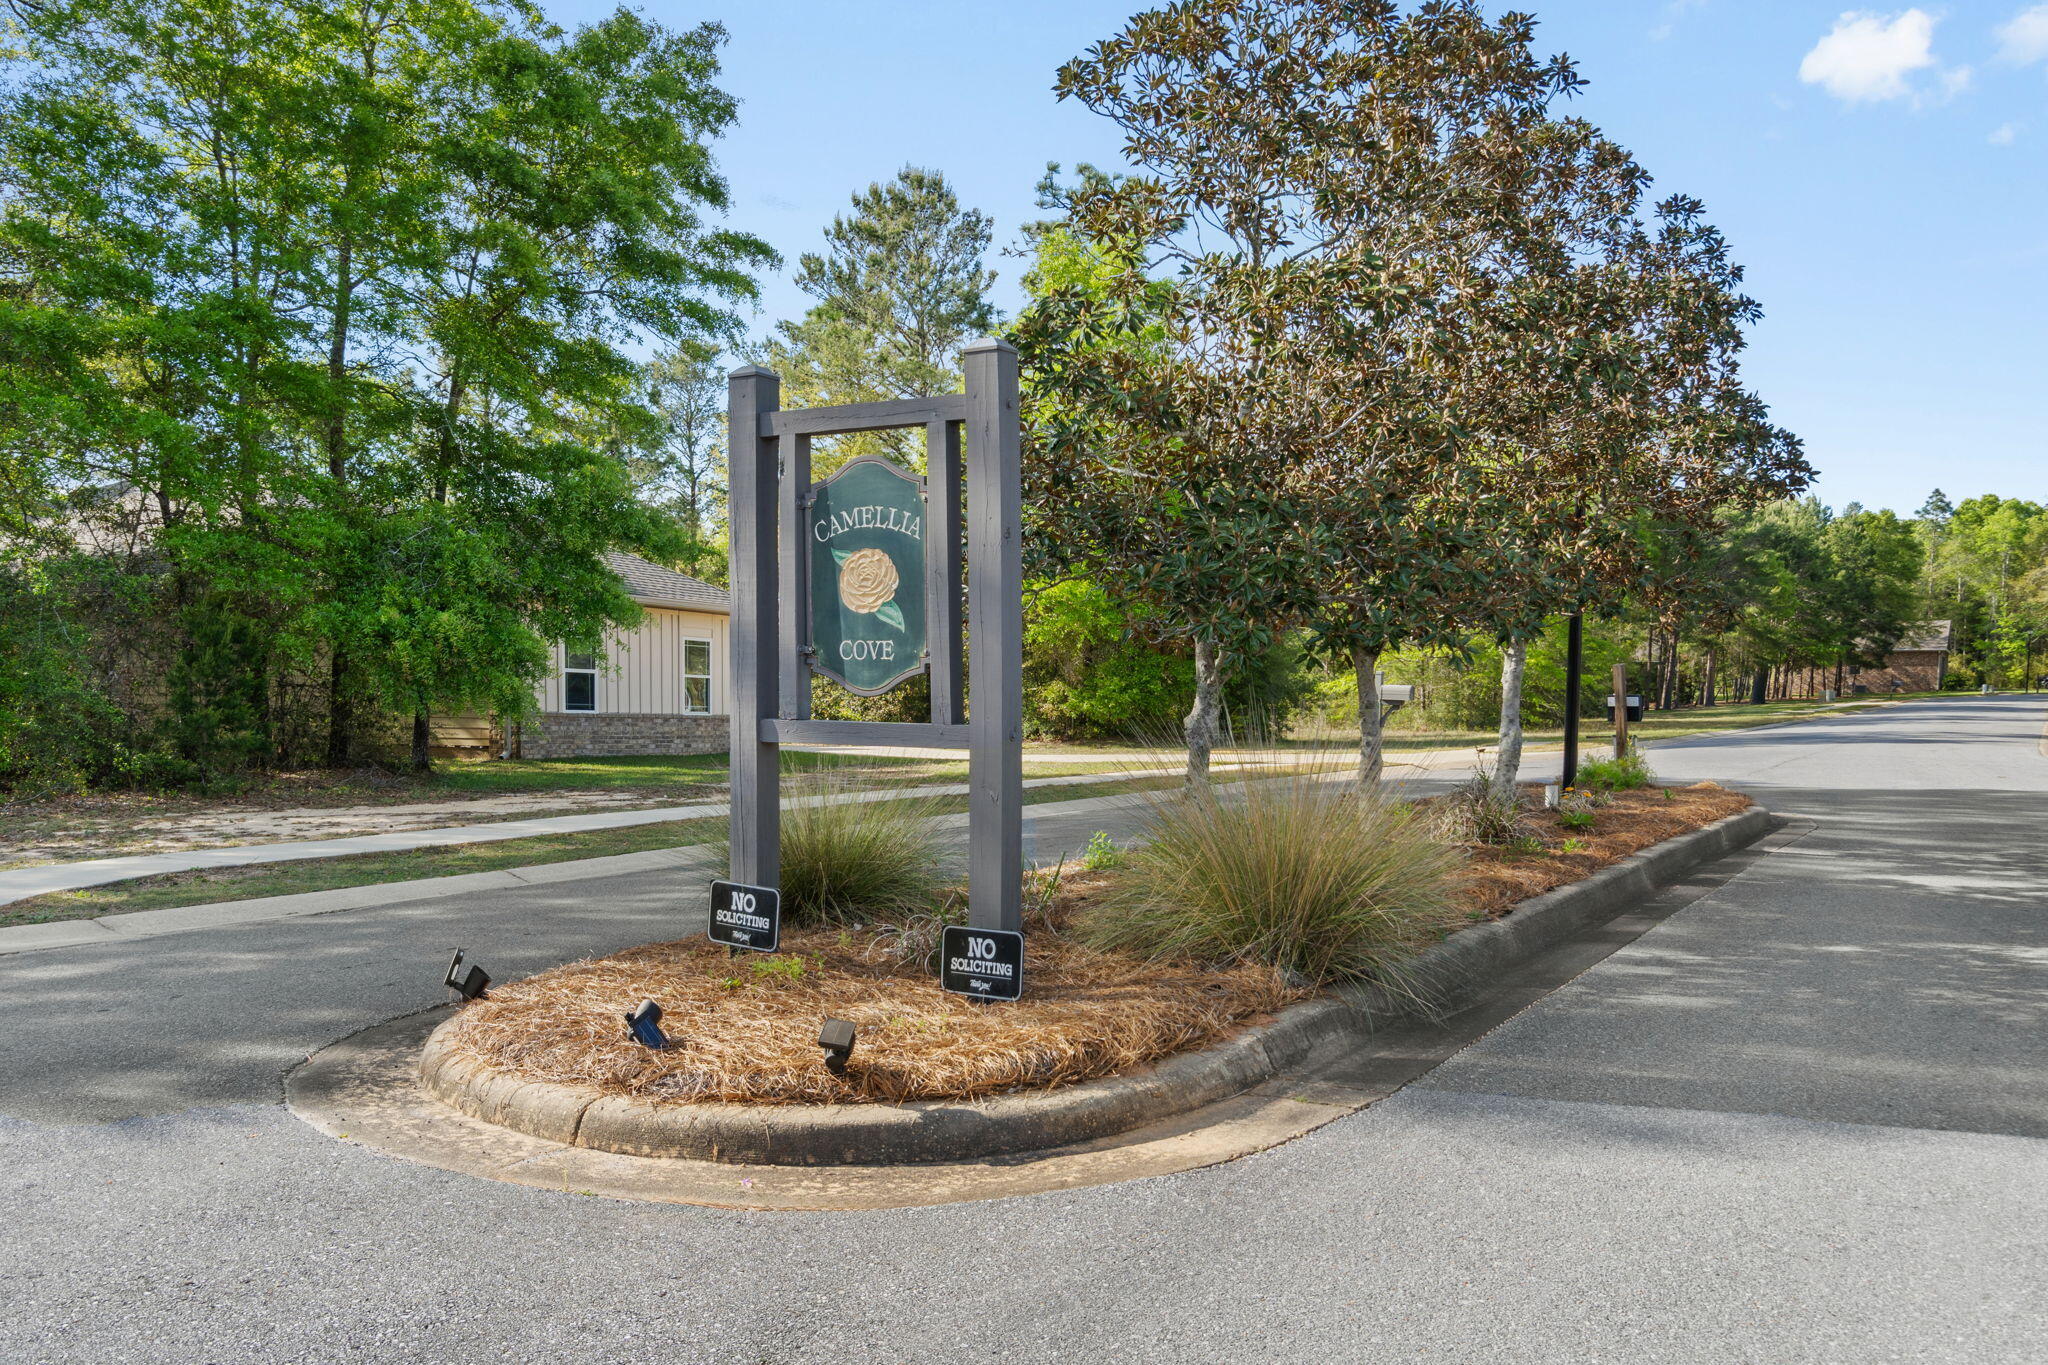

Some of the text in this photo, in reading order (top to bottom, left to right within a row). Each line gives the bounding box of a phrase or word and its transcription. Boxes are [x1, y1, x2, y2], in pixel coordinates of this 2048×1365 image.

[814, 504, 921, 543] CAMELLIA
[839, 639, 895, 662] COVE
[730, 891, 756, 913] NO
[716, 909, 770, 929] SOLICITING
[967, 936, 997, 960] NO
[950, 957, 1013, 977] SOLICITING
